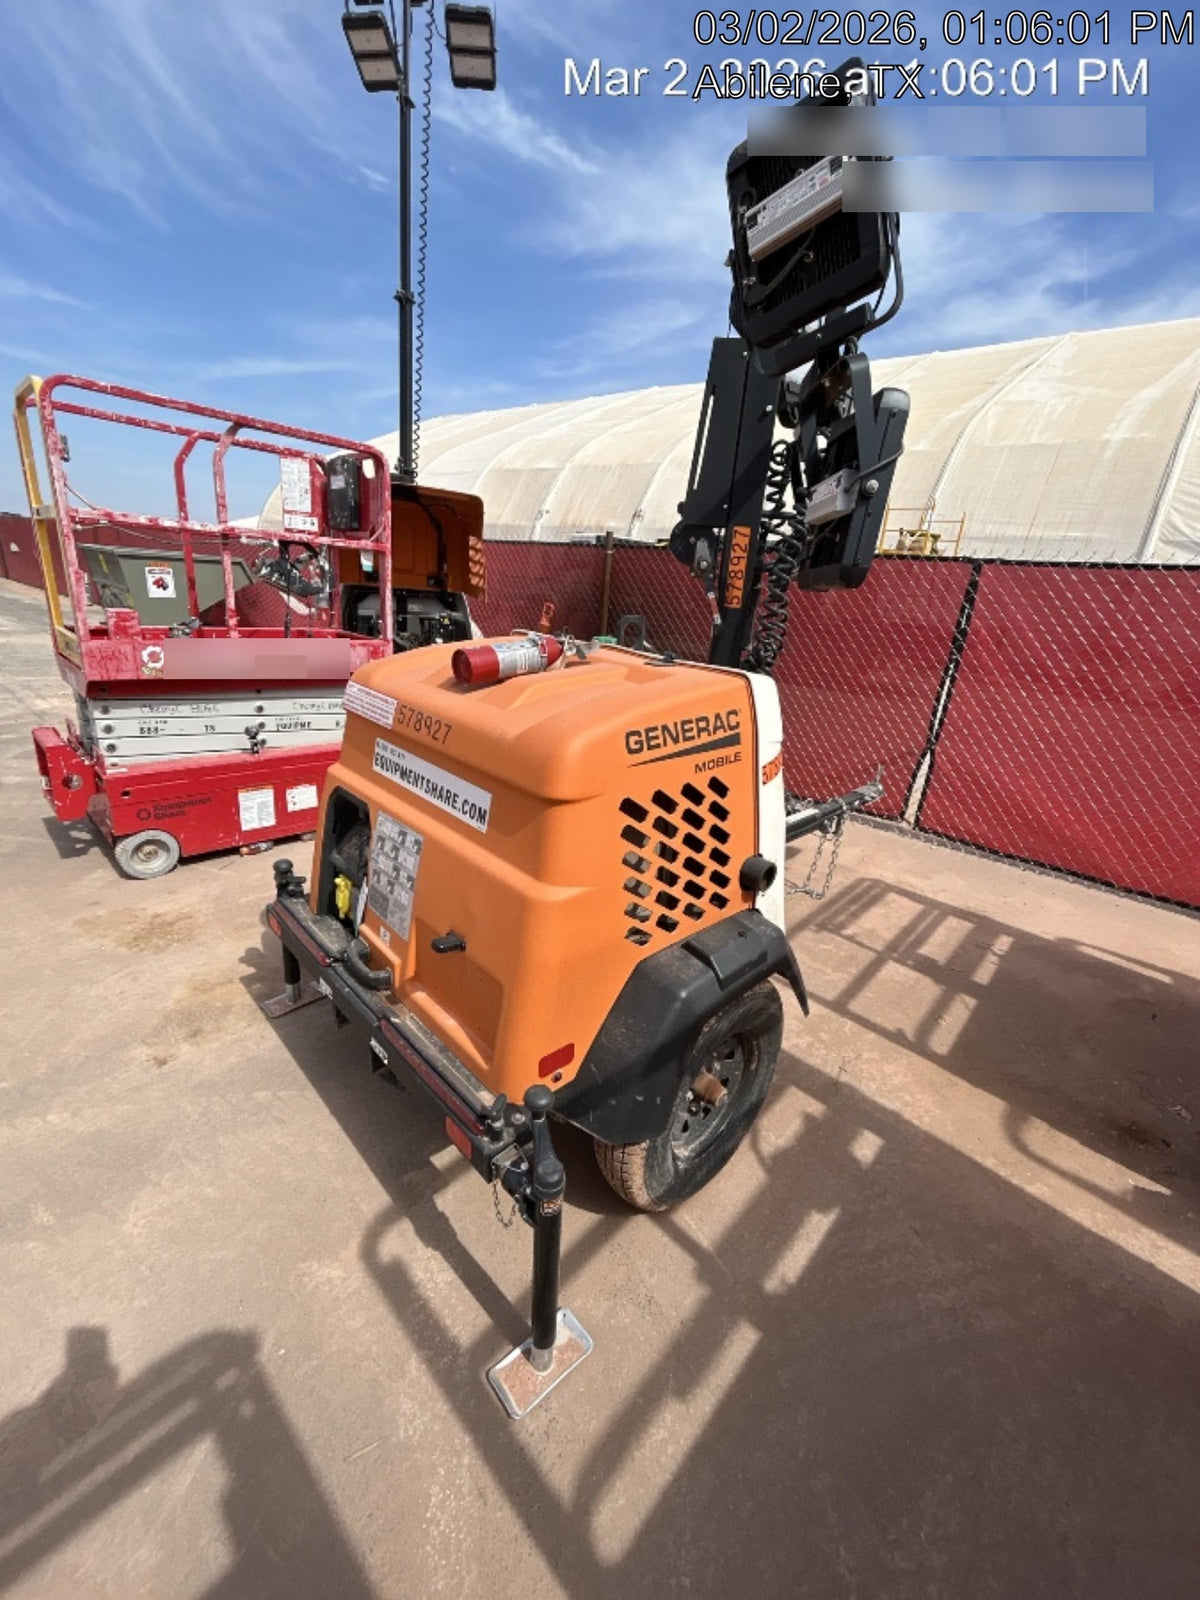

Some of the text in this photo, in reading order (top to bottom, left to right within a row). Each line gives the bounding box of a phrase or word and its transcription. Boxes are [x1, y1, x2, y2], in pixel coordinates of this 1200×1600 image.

[727, 529, 751, 606] 578927
[398, 704, 453, 745] 578927
[625, 709, 741, 755] GENERAC
[694, 751, 742, 774] MOBILE
[374, 752, 488, 825] EQUIPMENTSHARE.COM
